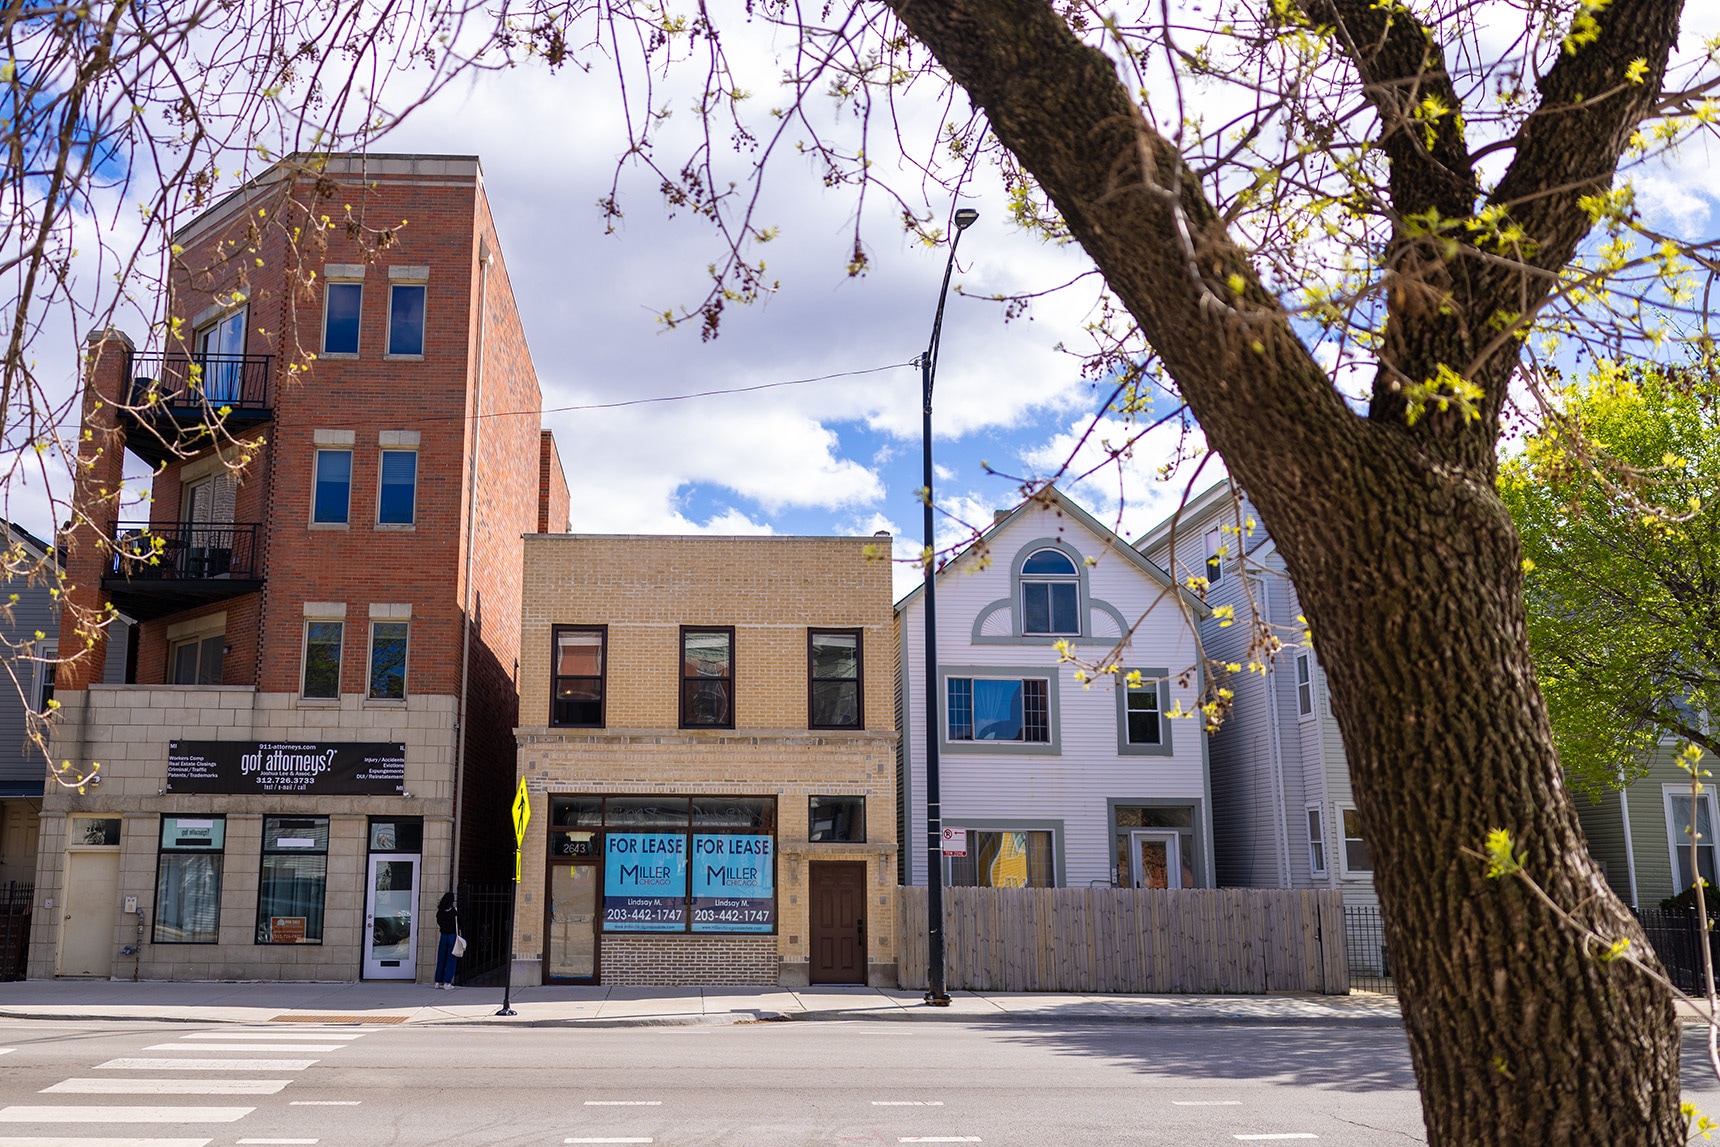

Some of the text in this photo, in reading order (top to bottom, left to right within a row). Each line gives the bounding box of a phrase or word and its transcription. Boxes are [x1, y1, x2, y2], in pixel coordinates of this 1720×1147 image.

[241, 750, 262, 776] got
[563, 844, 586, 854] 2643
[610, 838, 682, 854] FOR LEASE
[696, 839, 769, 855] FOR LEASE
[620, 864, 670, 885] MILLER
[707, 865, 757, 886] MILLER
[627, 899, 652, 907] Lindsay
[607, 909, 682, 920] 203-442-1747
[695, 910, 770, 921] 203-442-1747
